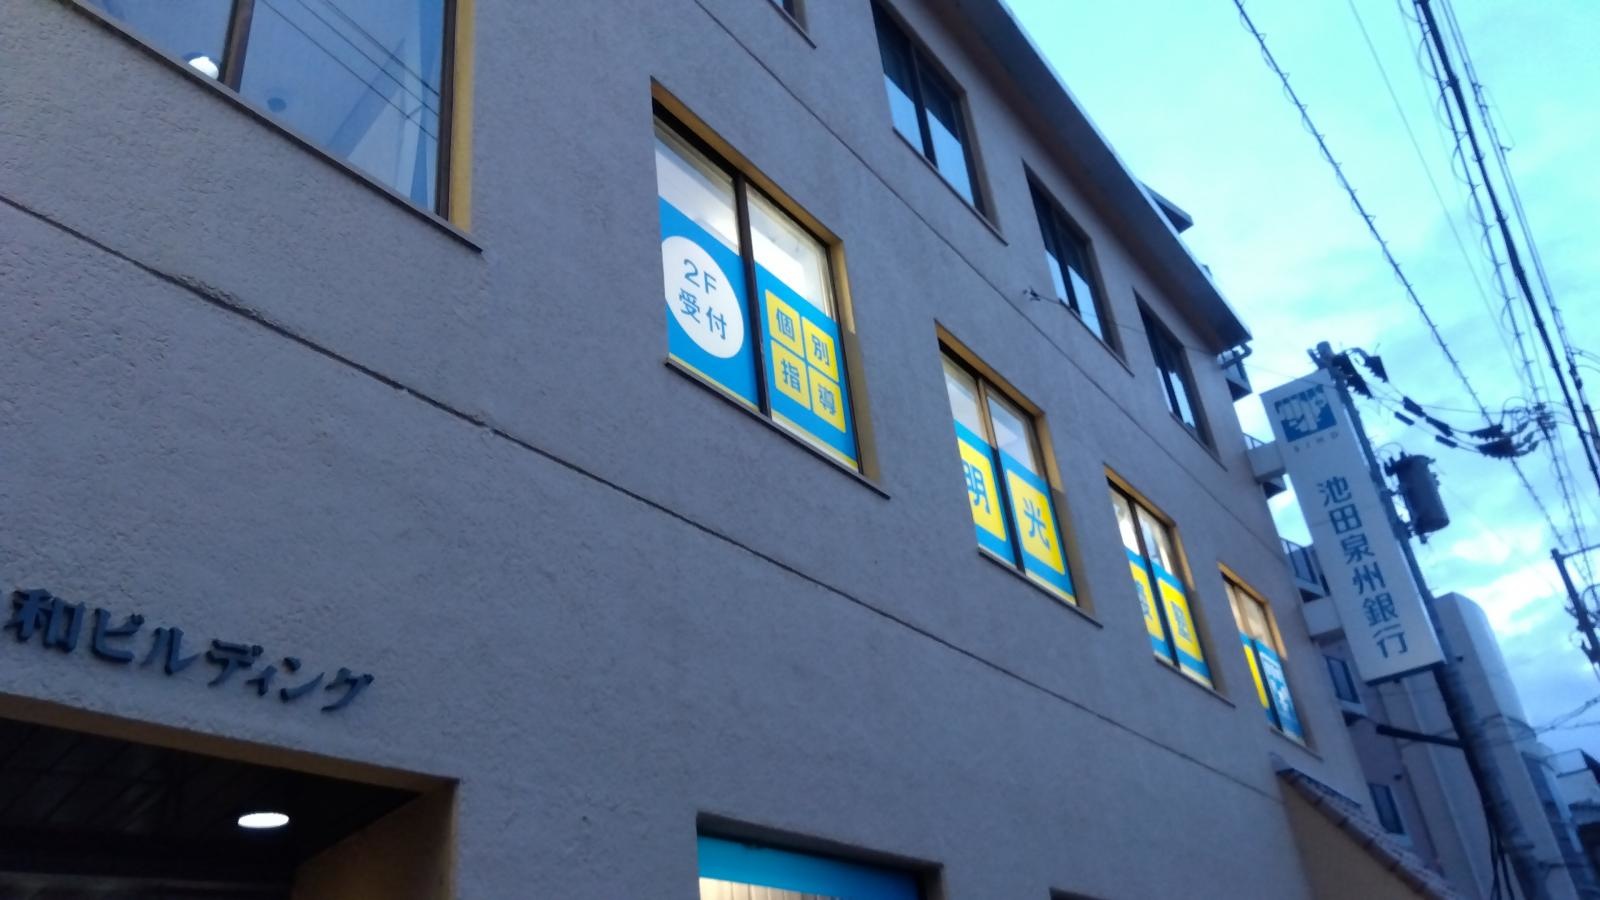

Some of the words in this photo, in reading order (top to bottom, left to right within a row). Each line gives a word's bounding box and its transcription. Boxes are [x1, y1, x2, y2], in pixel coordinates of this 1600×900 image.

[683, 258, 716, 293] 2F
[679, 288, 727, 340] 受付
[776, 309, 830, 366] 個別
[782, 360, 836, 415] 指導
[1317, 476, 1408, 658] 池田泉州銀行
